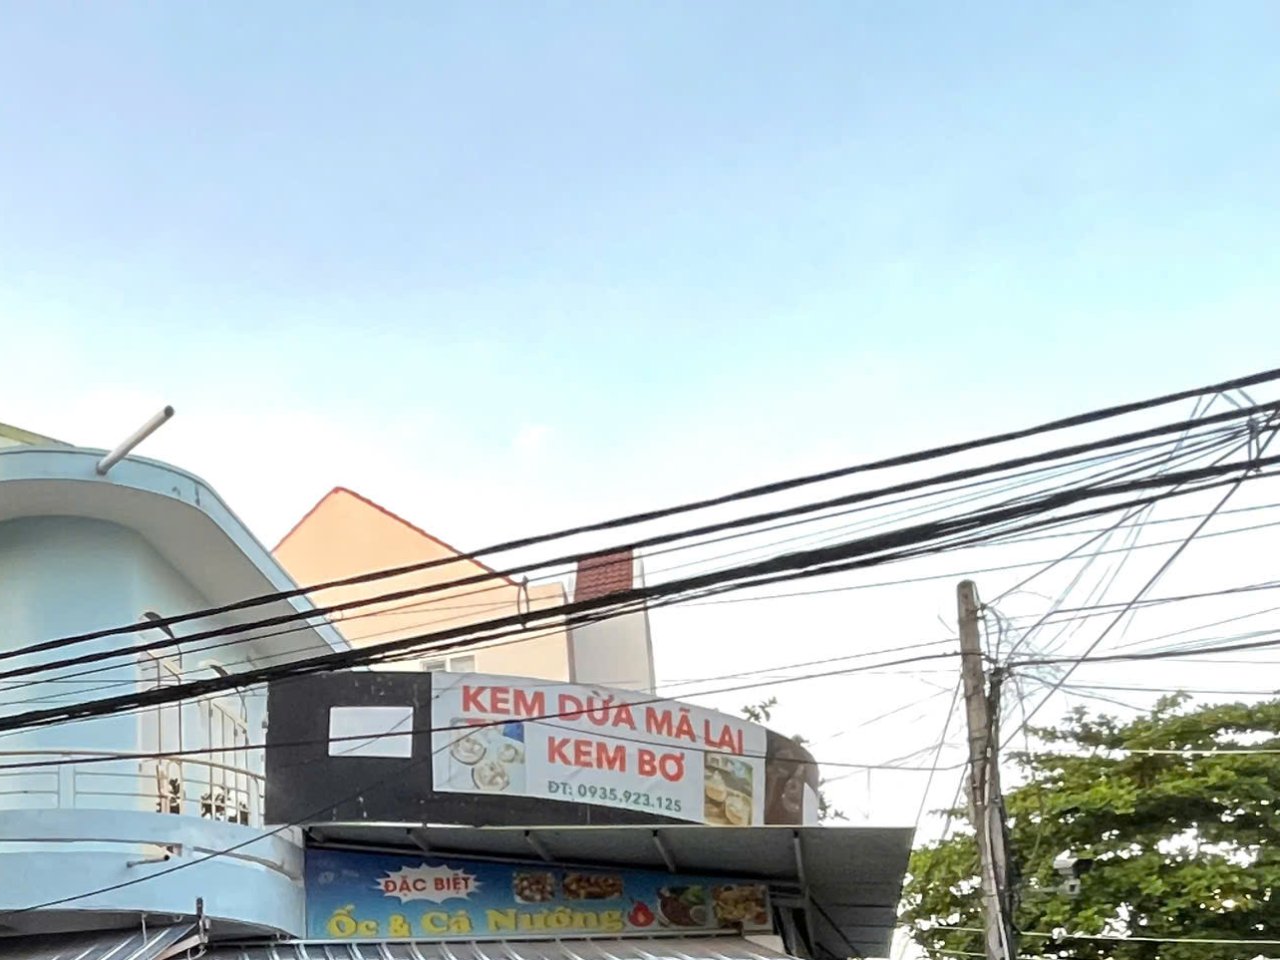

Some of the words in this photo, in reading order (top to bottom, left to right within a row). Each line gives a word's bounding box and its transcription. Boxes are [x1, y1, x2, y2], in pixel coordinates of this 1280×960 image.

[462, 685, 545, 717] KEM
[558, 690, 636, 731] DỪA
[646, 707, 697, 743] MÃ
[704, 719, 744, 755] LAI
[547, 736, 627, 773] KEM
[638, 748, 685, 783] BƠ
[577, 783, 682, 813] 0935.923.125
[328, 904, 377, 937] Ốc
[388, 915, 411, 937] &
[422, 909, 471, 933] Cá
